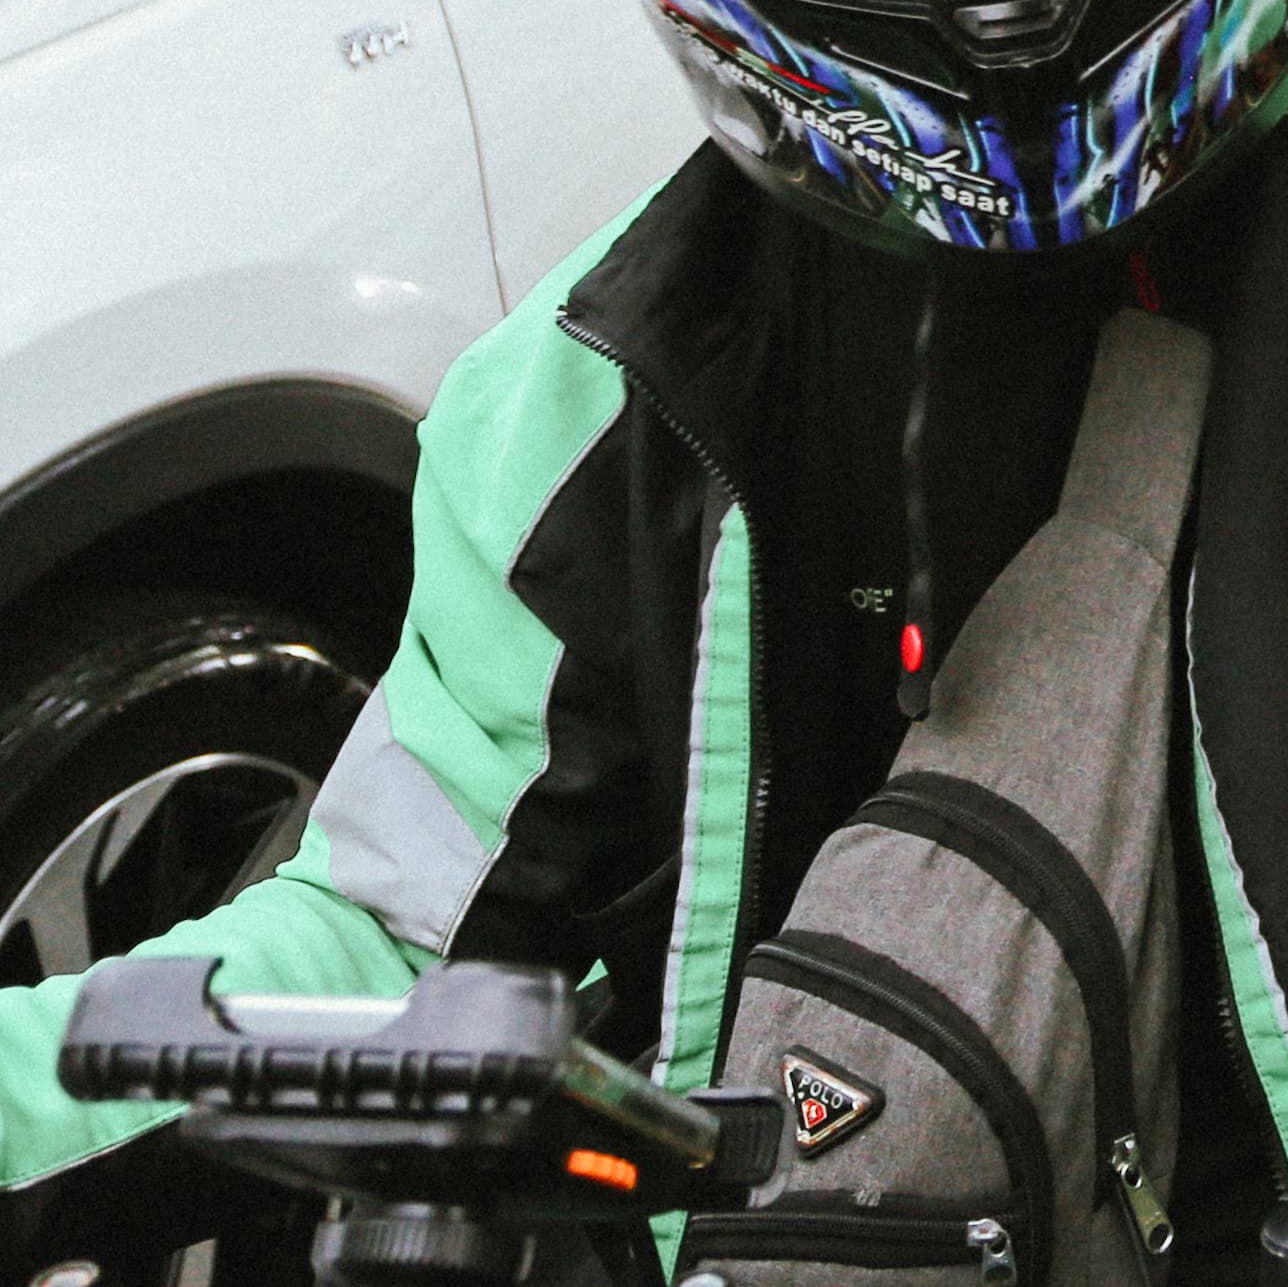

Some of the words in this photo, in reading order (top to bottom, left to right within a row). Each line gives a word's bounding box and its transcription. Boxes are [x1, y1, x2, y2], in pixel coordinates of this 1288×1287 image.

[801, 110, 846, 145] dan
[851, 139, 933, 193] setiap
[941, 183, 1010, 217] saat
[797, 1074, 844, 1110] POLO
